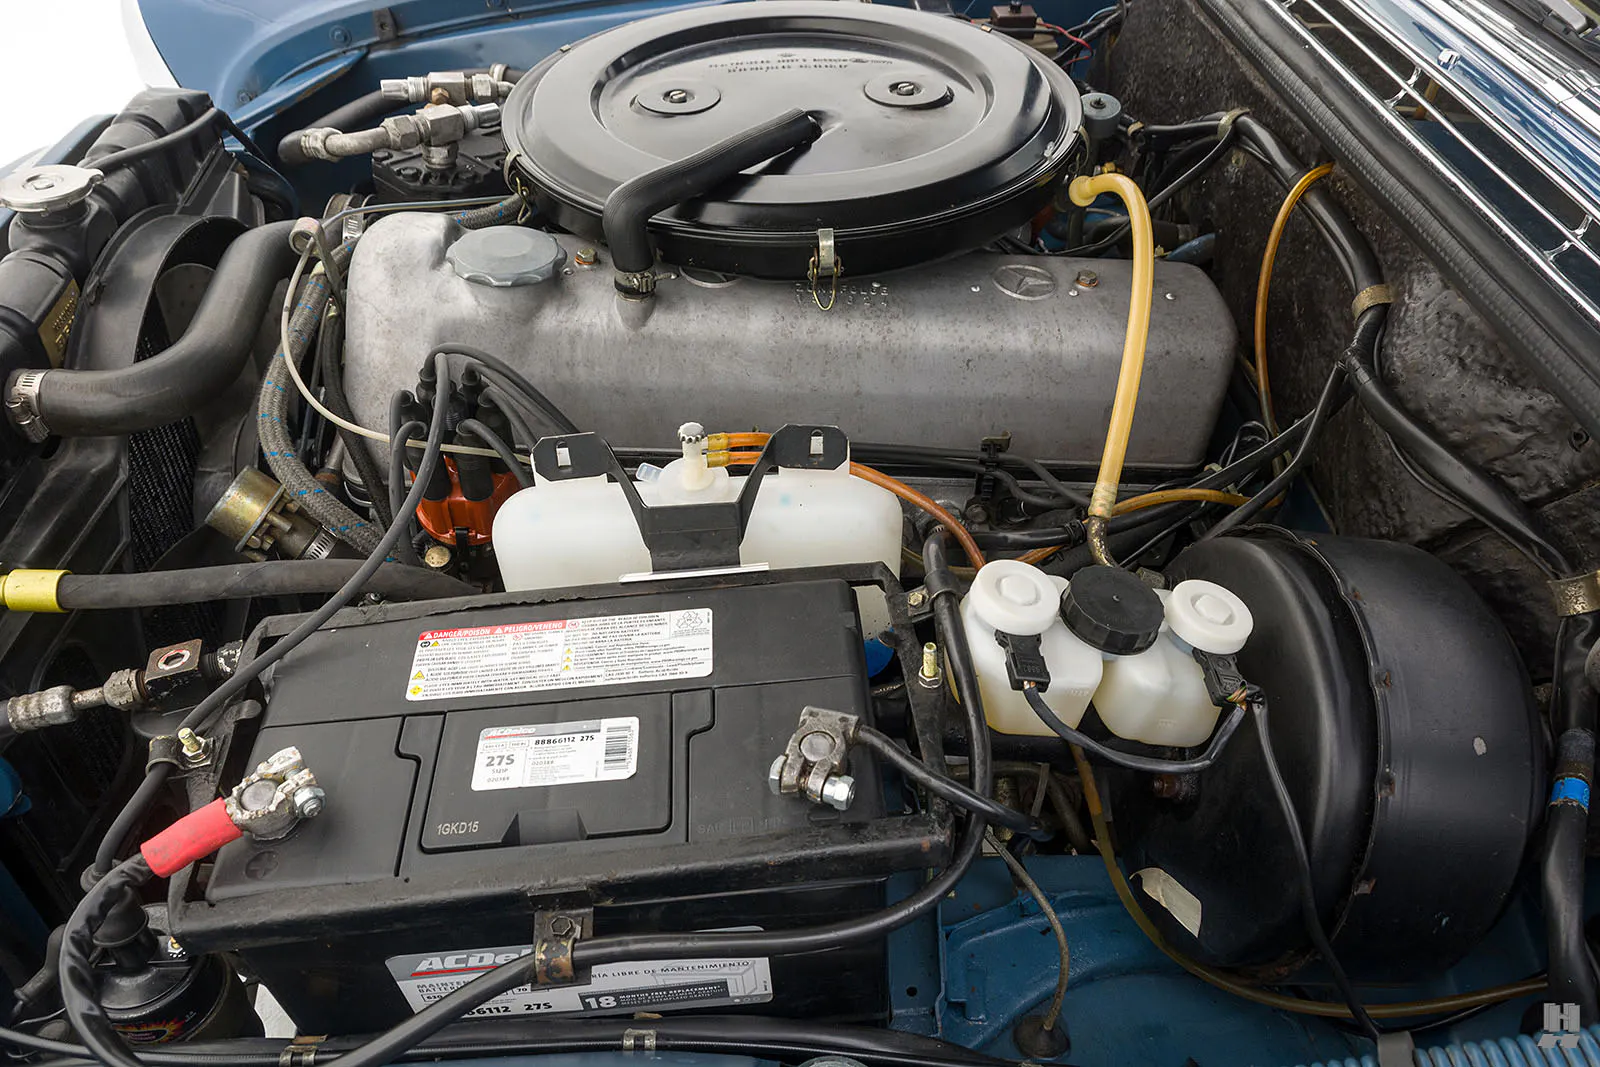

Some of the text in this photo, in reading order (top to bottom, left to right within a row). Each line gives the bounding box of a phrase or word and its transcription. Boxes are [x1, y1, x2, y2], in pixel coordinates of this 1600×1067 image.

[433, 622, 563, 639] DANGER/POISON PELIGRO/VENENO
[534, 736, 575, 746] 88866112
[612, 969, 639, 978] LIBRE
[660, 960, 750, 974] MANTENIMIENTO
[585, 996, 617, 1010] 18
